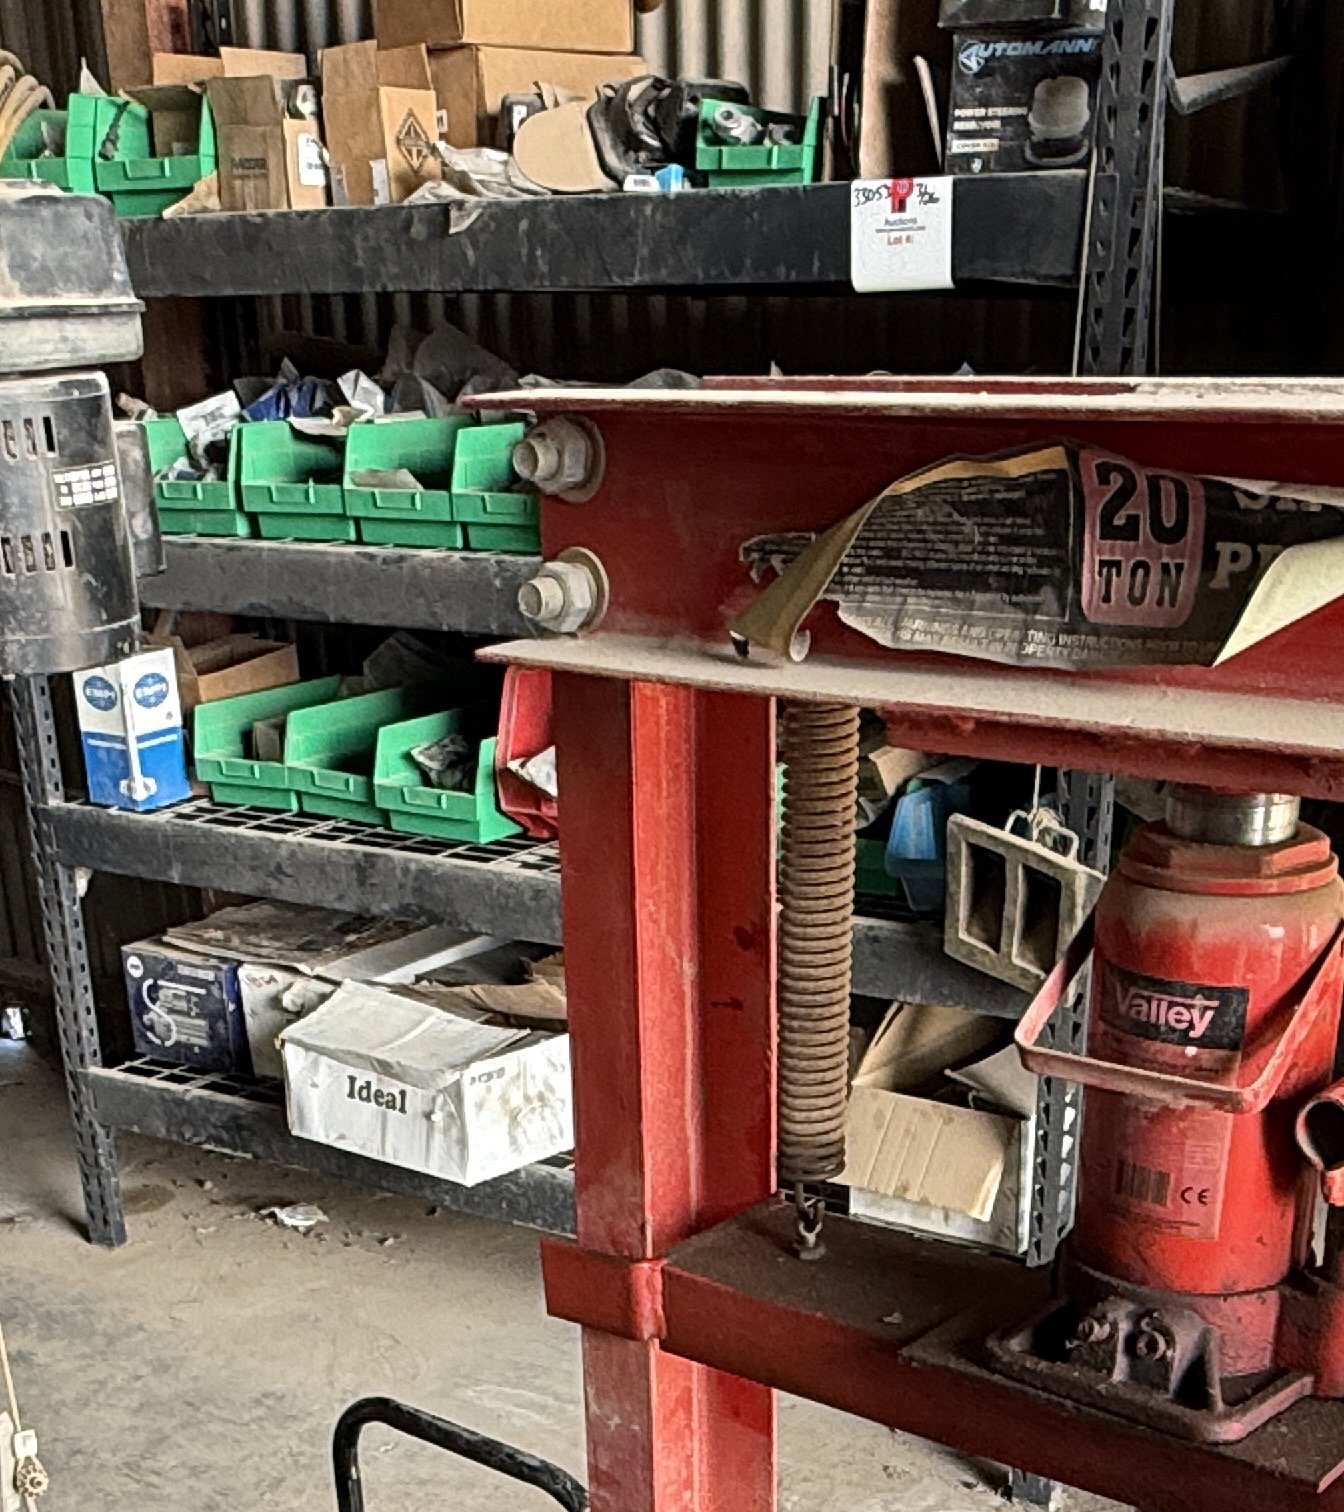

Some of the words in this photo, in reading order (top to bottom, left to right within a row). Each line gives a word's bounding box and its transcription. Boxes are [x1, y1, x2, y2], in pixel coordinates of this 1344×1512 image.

[959, 38, 1097, 62] AUTOMANN
[1094, 459, 1191, 546] 20
[1097, 558, 1186, 609] TON
[1113, 979, 1220, 1038] Valley
[346, 1074, 408, 1115] Ideal
